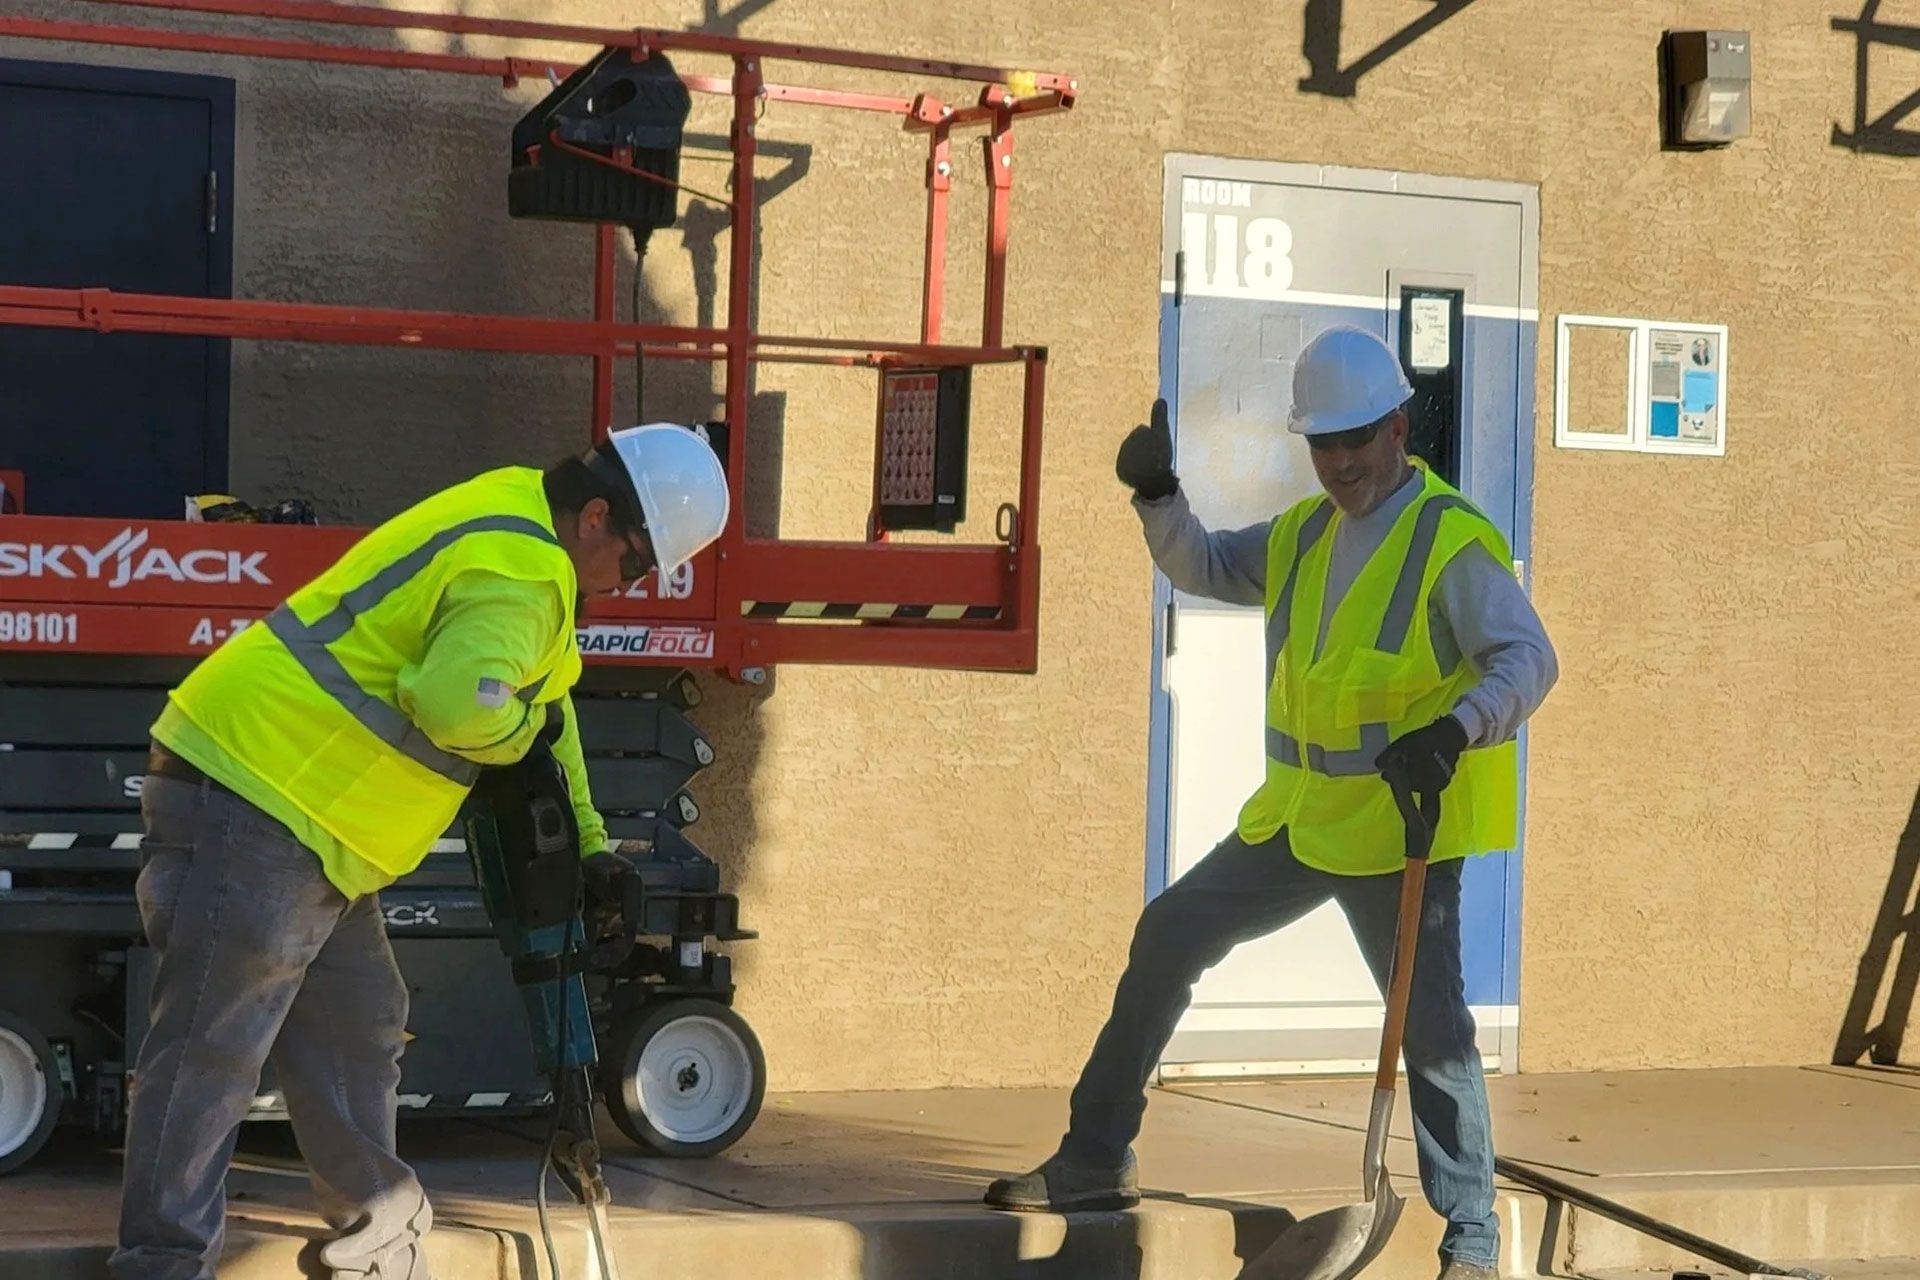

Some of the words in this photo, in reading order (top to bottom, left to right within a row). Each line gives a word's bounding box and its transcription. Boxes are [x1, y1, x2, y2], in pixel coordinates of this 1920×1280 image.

[1183, 179, 1251, 207] ROOM
[1182, 212, 1294, 294] 118
[0, 526, 273, 588] SKYJACK
[0, 611, 77, 643] 98101
